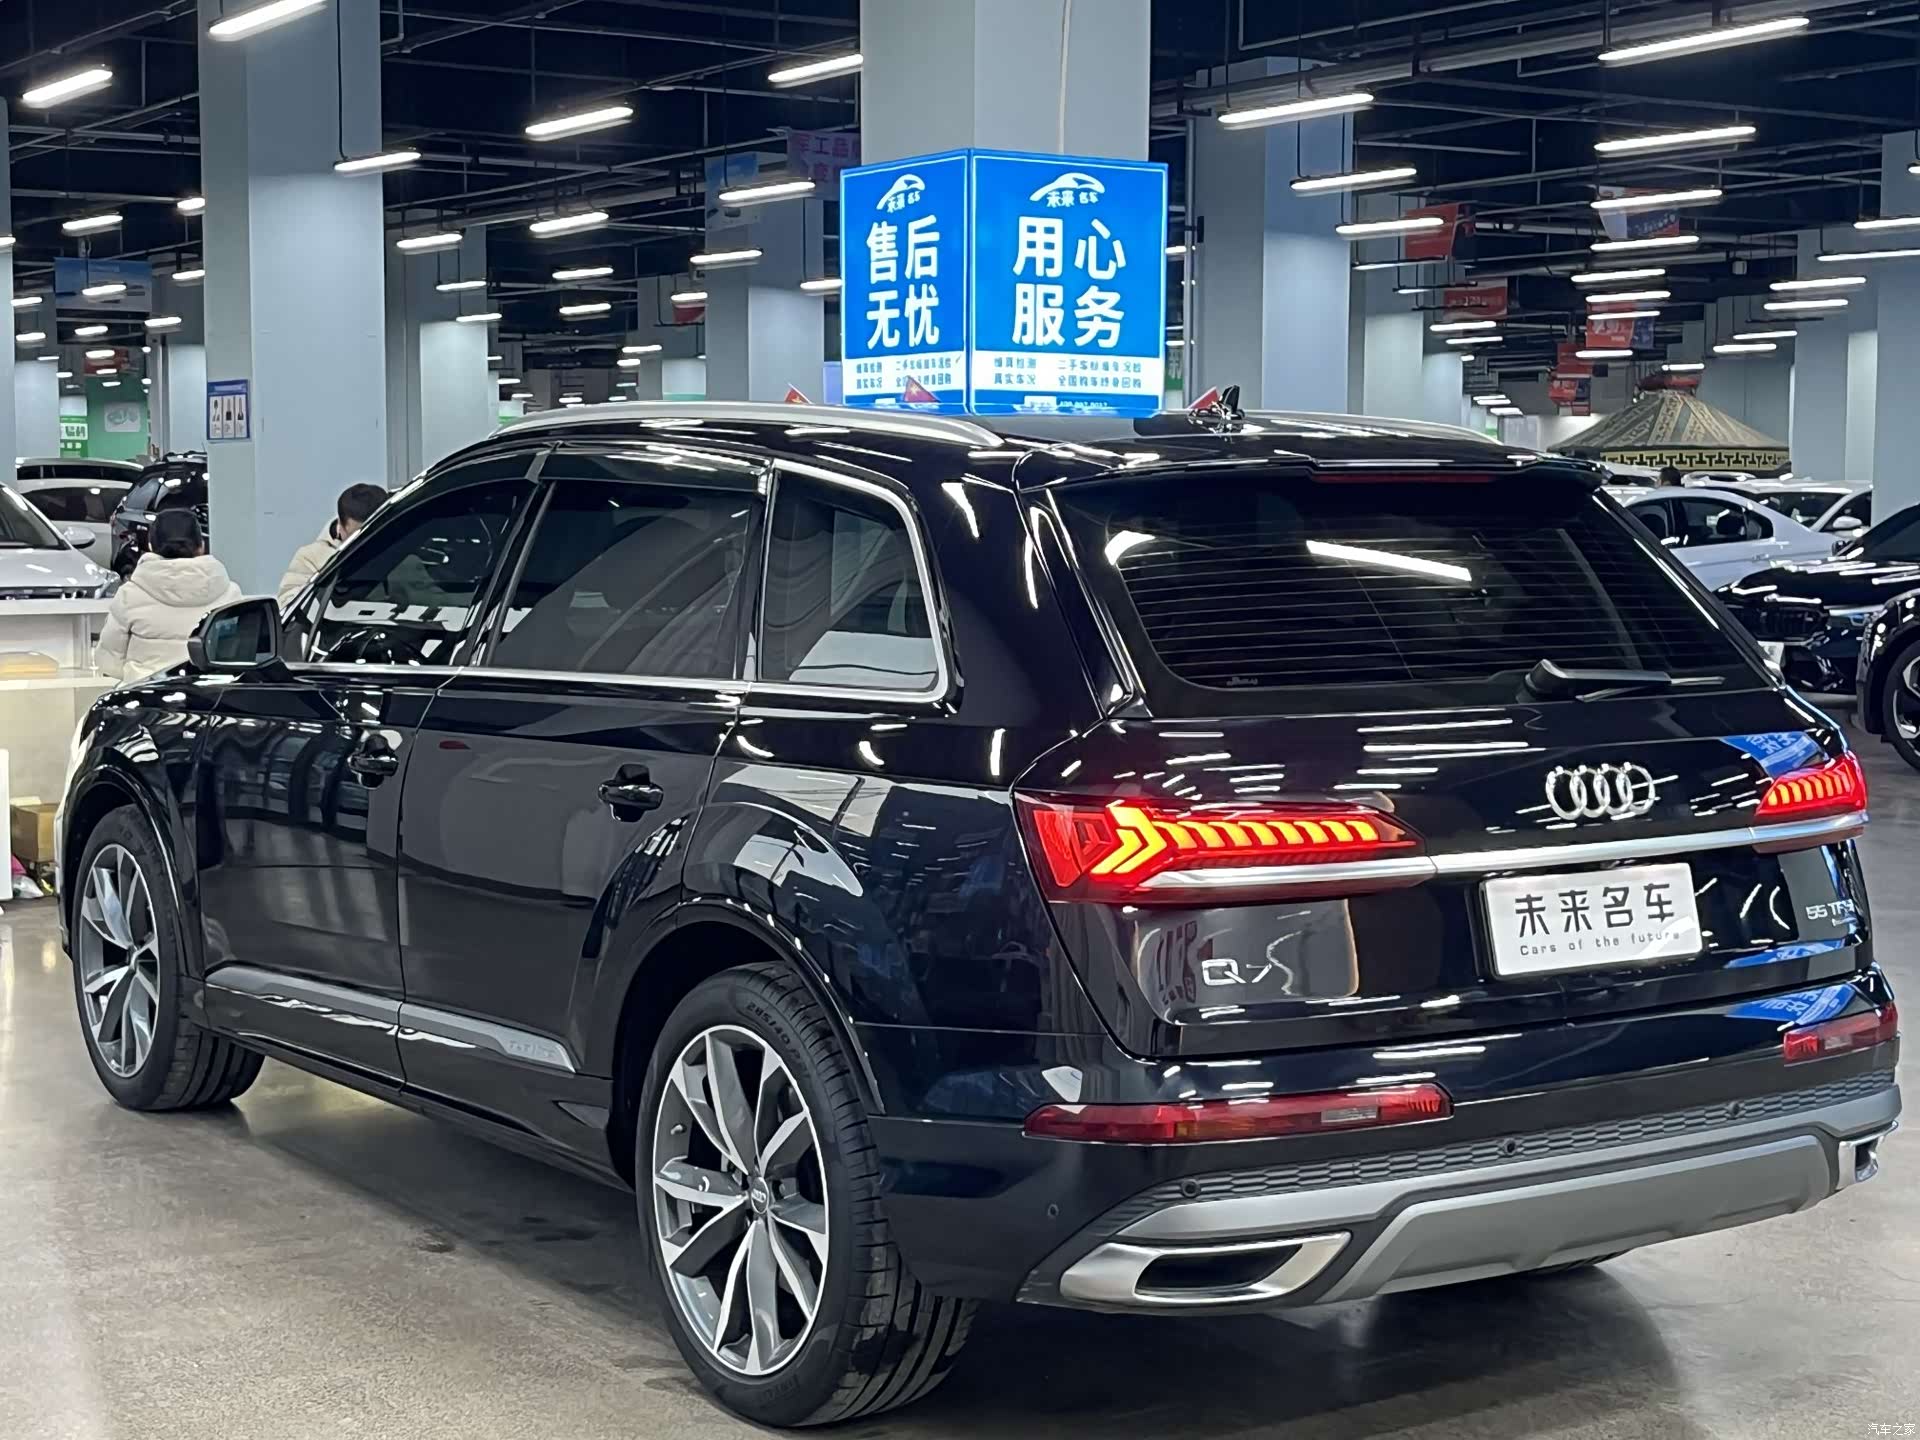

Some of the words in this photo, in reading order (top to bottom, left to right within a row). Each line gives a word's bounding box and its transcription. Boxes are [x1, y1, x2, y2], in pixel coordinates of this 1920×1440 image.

[866, 214, 940, 284] 售后
[1013, 216, 1126, 280] 用心
[866, 284, 939, 350] 无忧
[1012, 283, 1125, 349] 服务
[1515, 883, 1674, 938] 未来名车
[1806, 904, 1828, 920] 55
[1202, 958, 1272, 986] Q7
[1519, 943, 1557, 956] Cars
[1568, 938, 1584, 951] of
[1595, 935, 1620, 948] the
[1631, 930, 1681, 945] future
